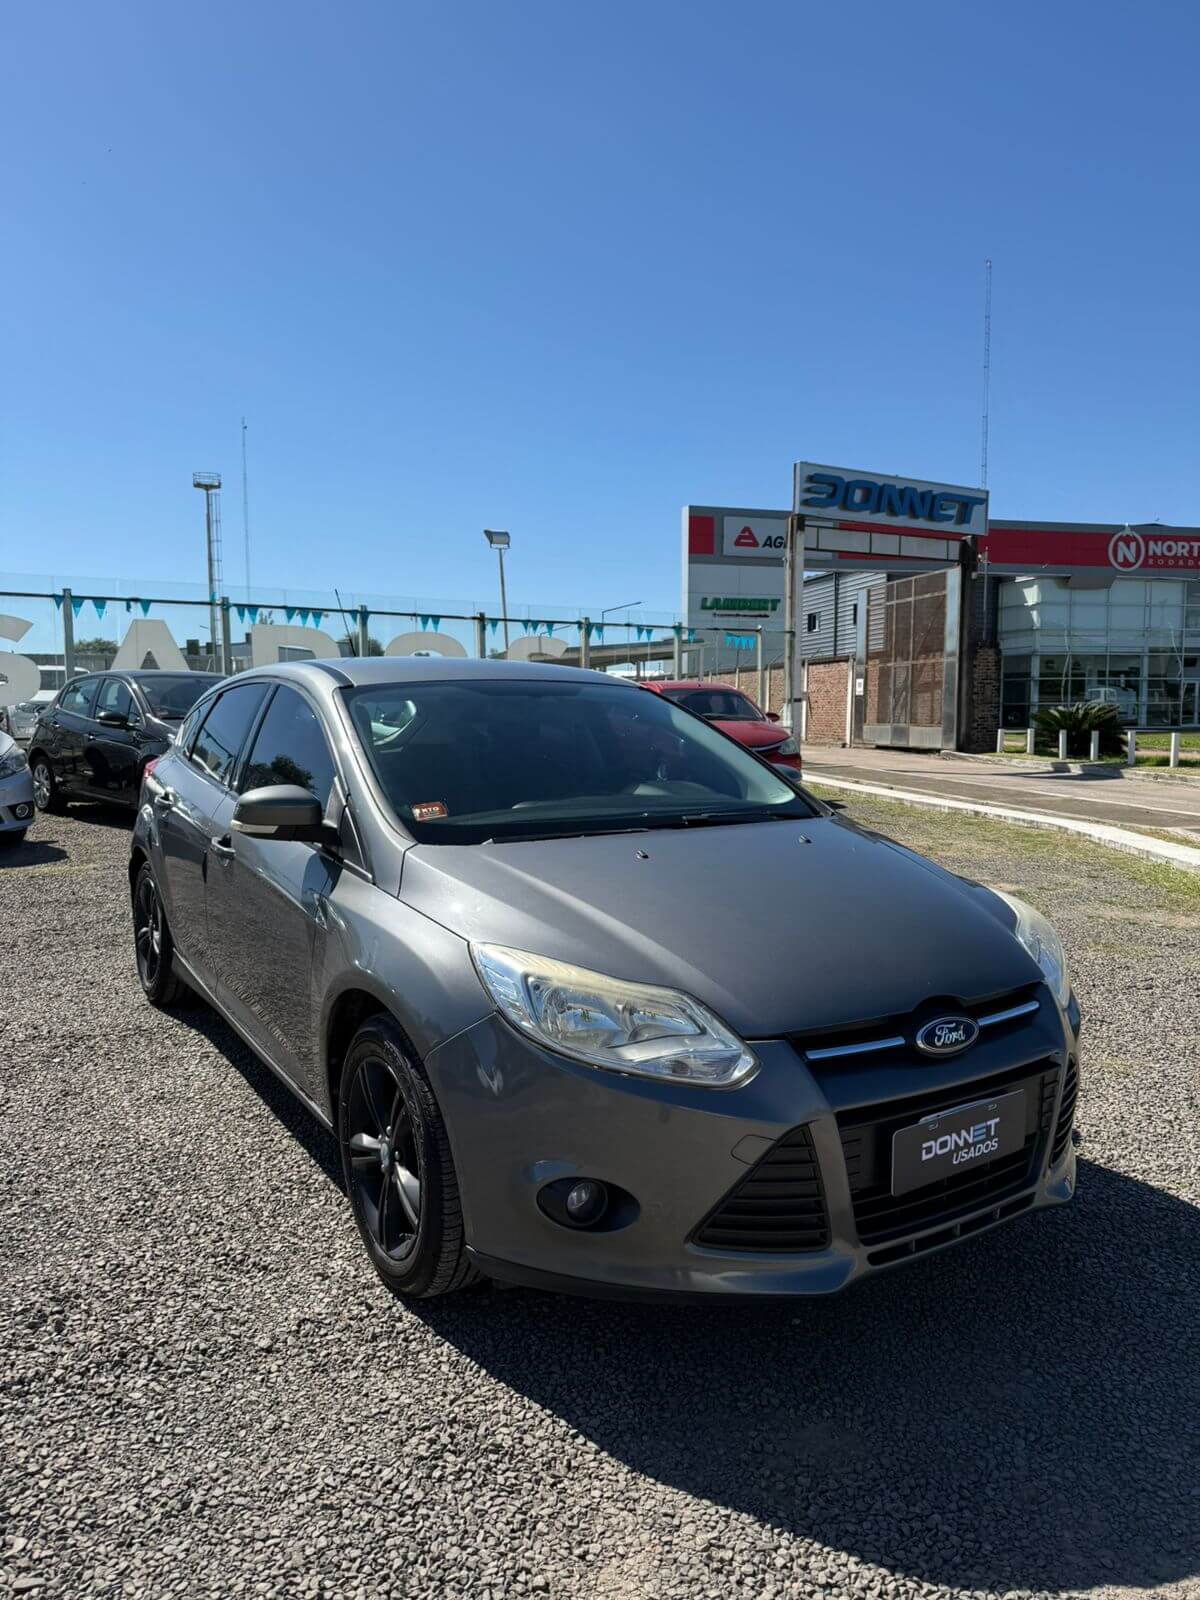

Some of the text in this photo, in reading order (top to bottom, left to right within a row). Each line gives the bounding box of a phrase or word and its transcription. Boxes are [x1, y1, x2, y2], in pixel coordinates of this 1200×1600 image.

[801, 472, 985, 526] DONNET
[762, 535, 787, 549] AG
[934, 1022, 966, 1047] Ford
[921, 1117, 1000, 1161] DONNET
[952, 1138, 999, 1165] USADOS
